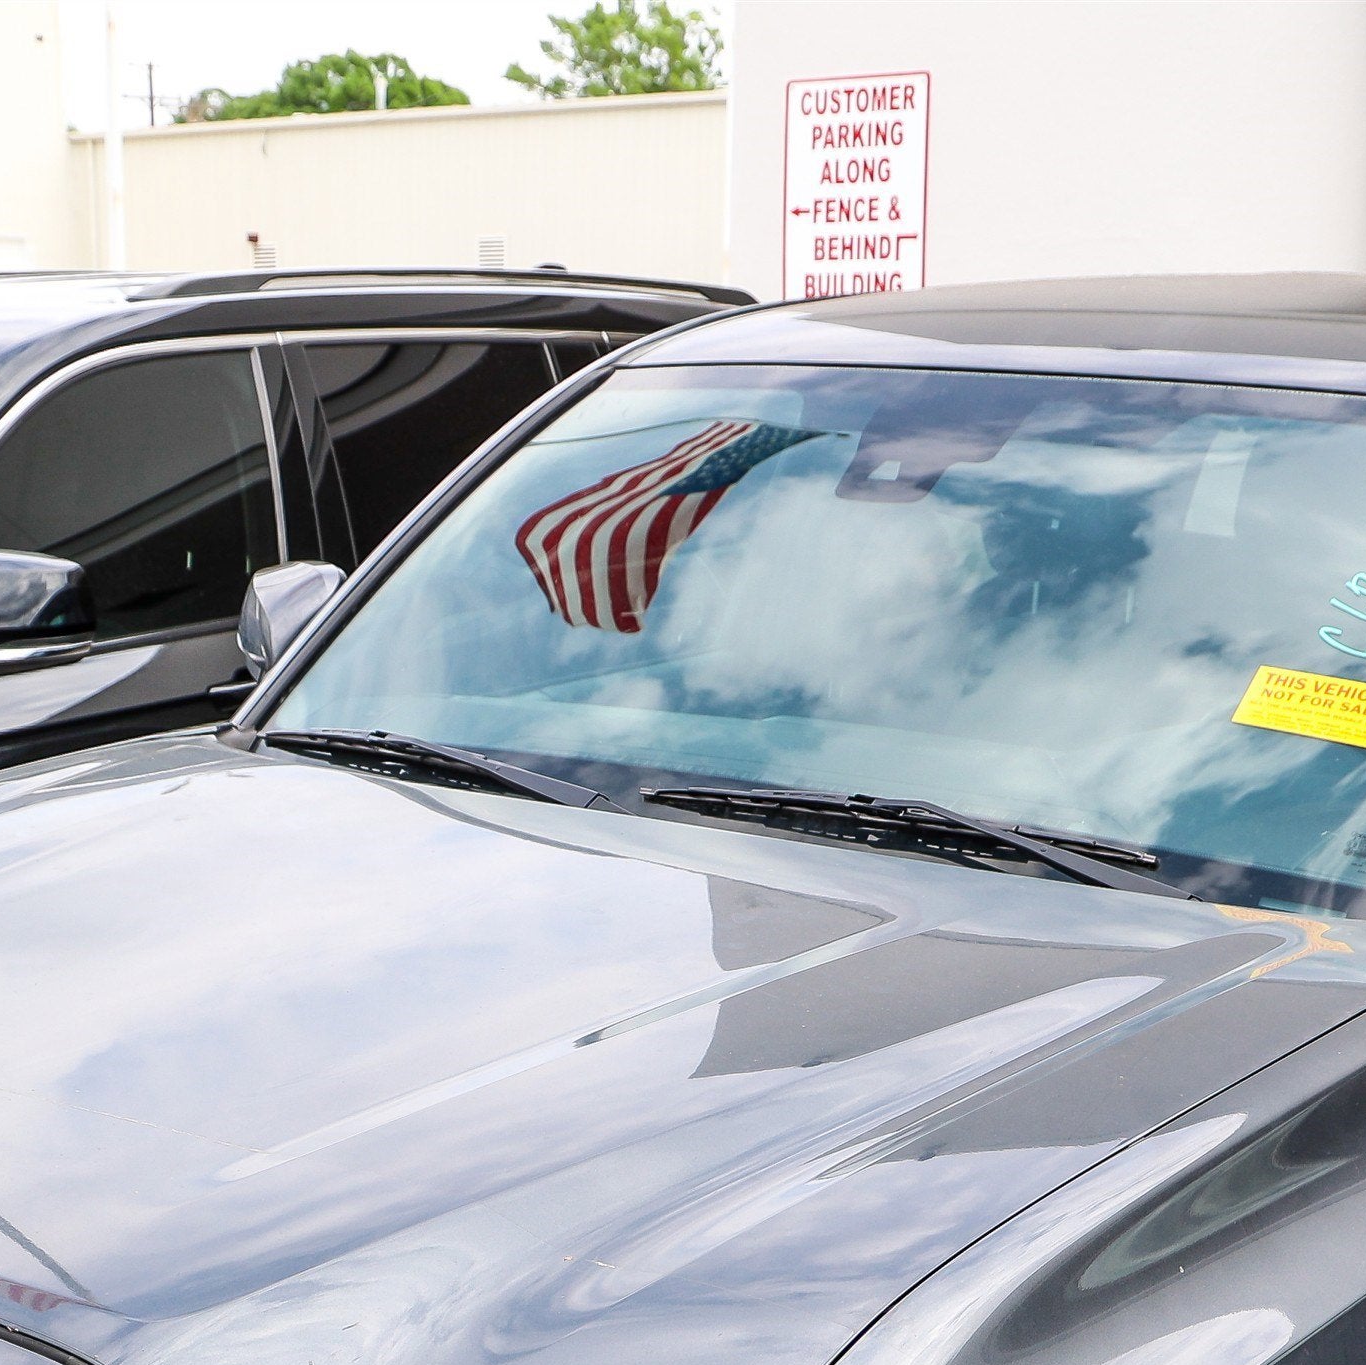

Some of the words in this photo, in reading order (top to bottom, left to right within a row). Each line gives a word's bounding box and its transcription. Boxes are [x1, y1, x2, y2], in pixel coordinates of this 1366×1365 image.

[801, 84, 916, 116] CUSTOMER
[811, 121, 904, 150] PARKING
[820, 157, 891, 185] ALONG
[813, 197, 879, 223] FENCE
[888, 195, 901, 220] &
[814, 234, 892, 261] BEHIND
[804, 273, 903, 299] BUILDING
[1265, 672, 1307, 690] THIS
[1260, 688, 1295, 704] NOT
[1299, 694, 1335, 709] FOR
